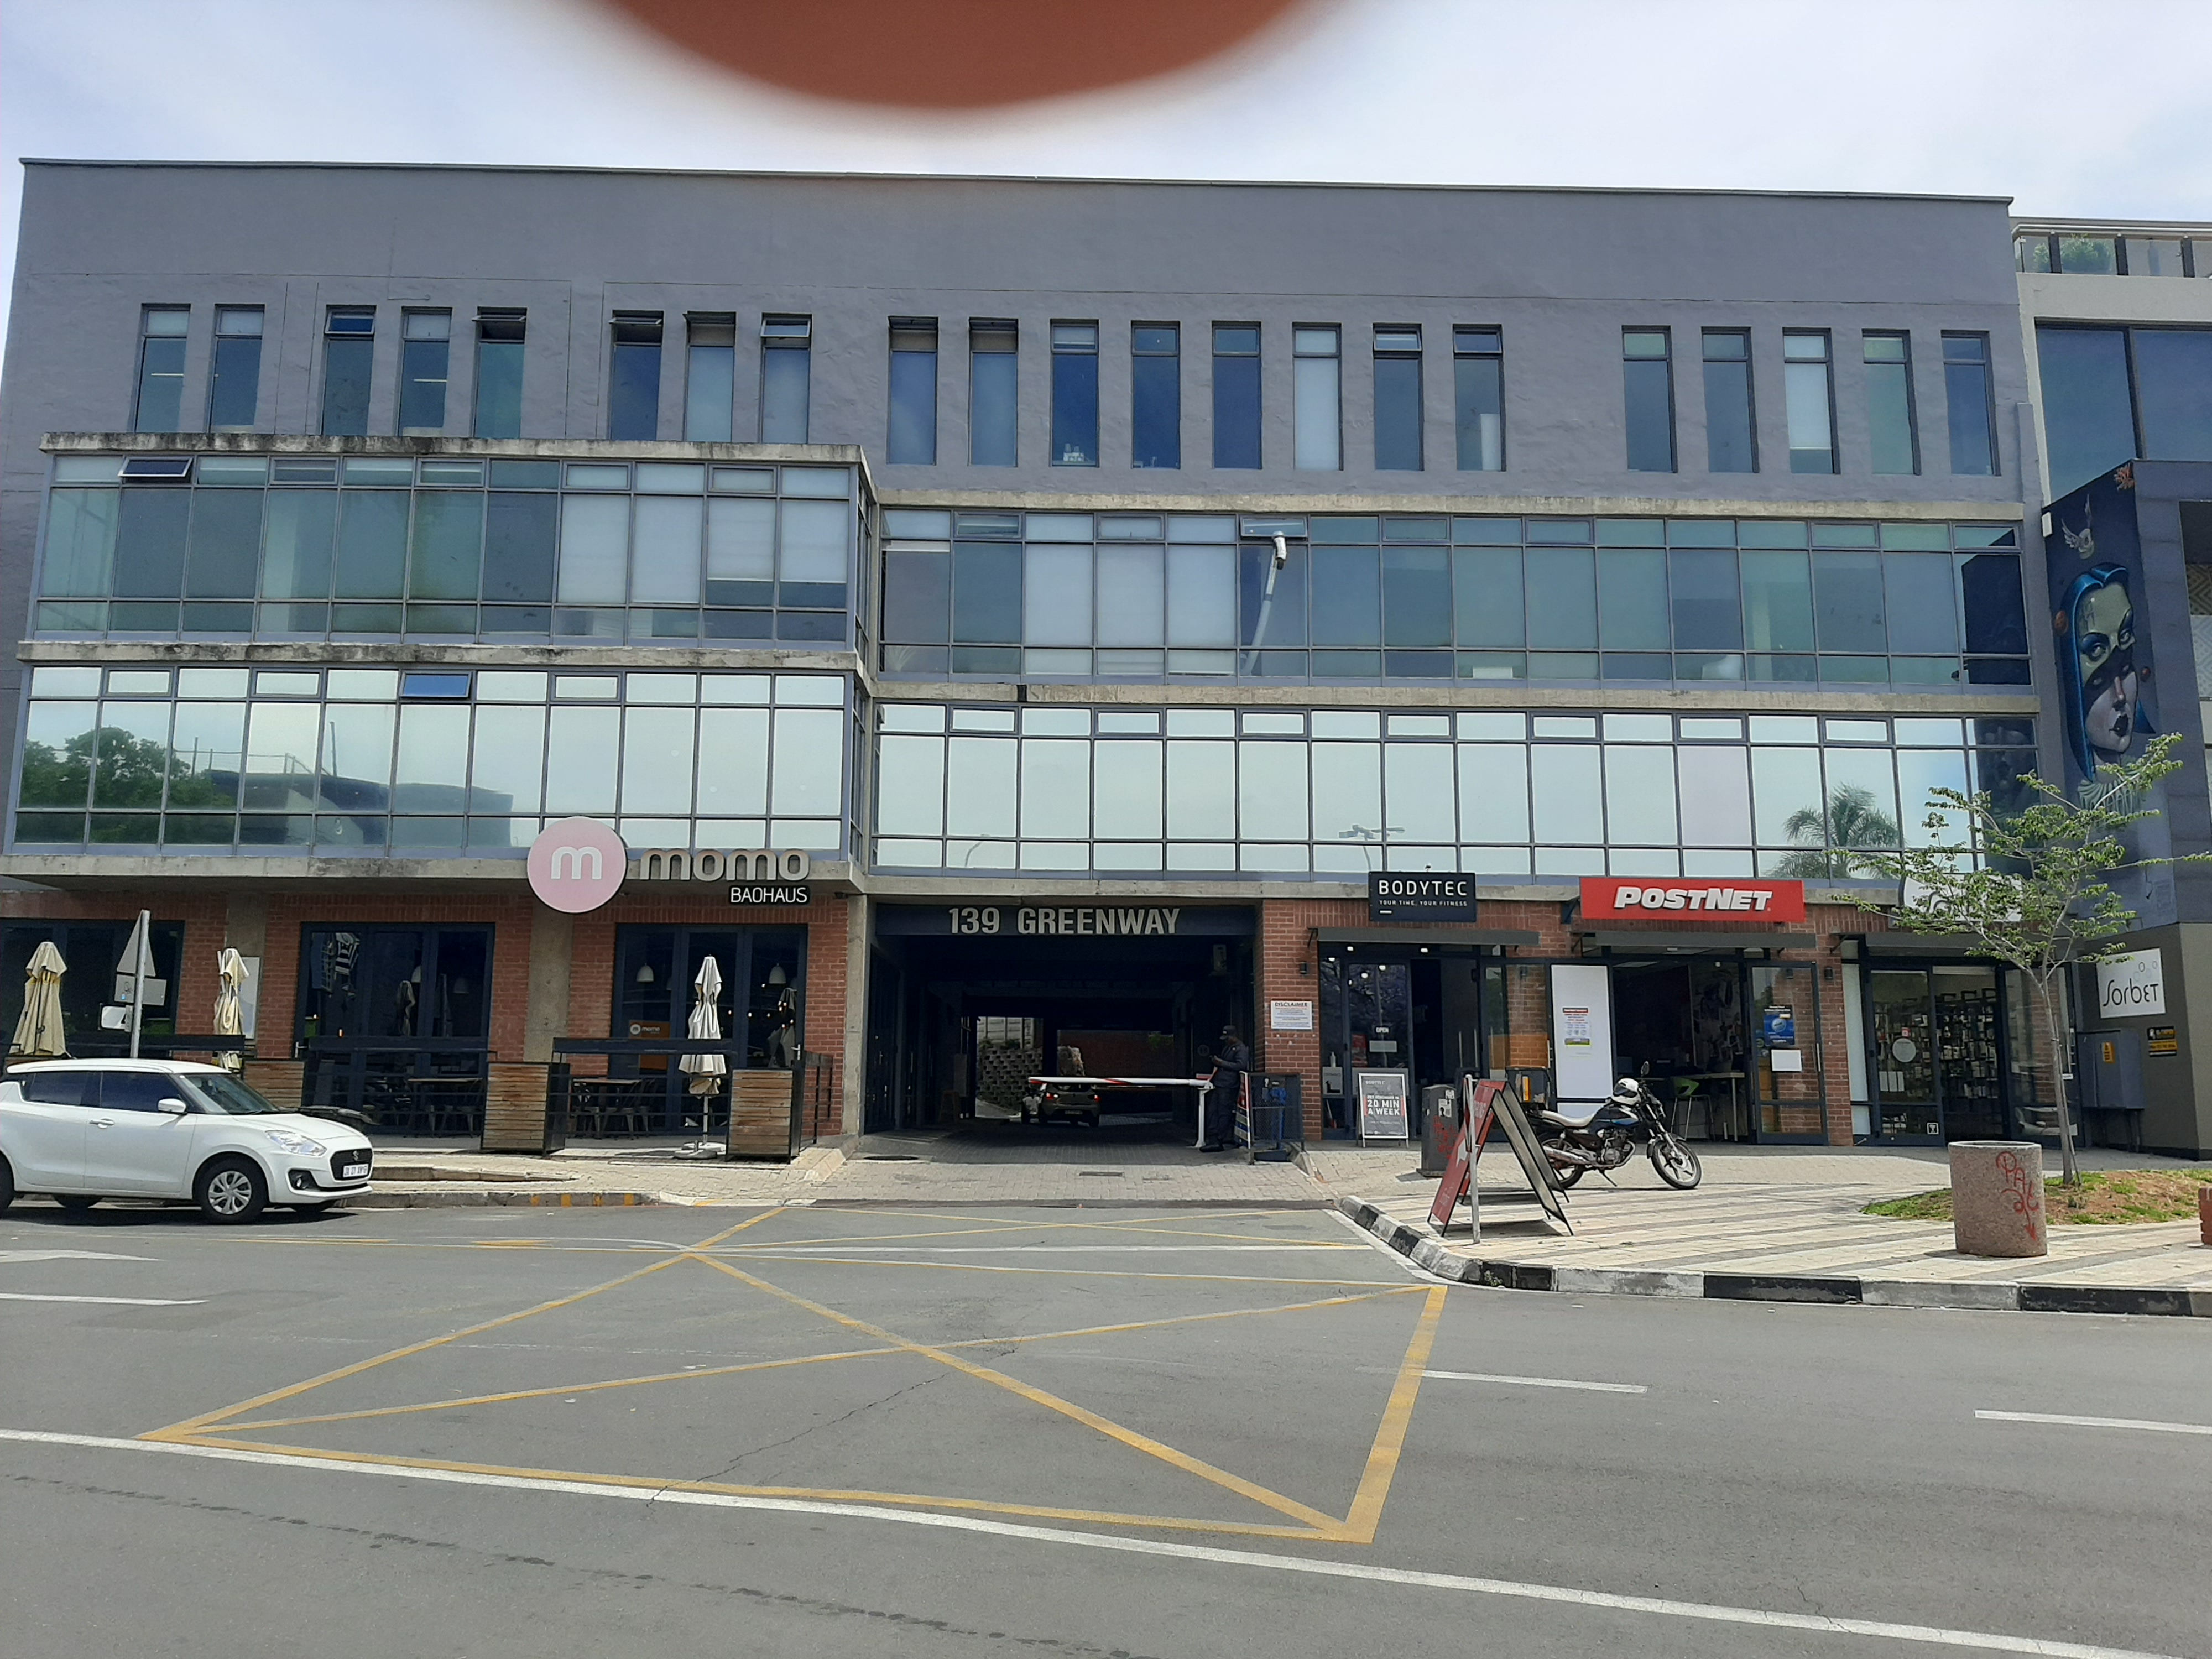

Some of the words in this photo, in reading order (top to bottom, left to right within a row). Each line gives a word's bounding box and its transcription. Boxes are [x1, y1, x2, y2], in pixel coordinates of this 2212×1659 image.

[551, 846, 602, 879] m
[639, 848, 810, 881] momo
[731, 887, 807, 903] BAOHAUS
[1379, 880, 1467, 896] BODYTEC
[1615, 886, 1773, 911] POSTNET
[948, 907, 1000, 934] 139
[1018, 908, 1180, 935] GREENWAY
[1367, 1099, 1379, 1108] 20
[1382, 1100, 1400, 1108] MIN
